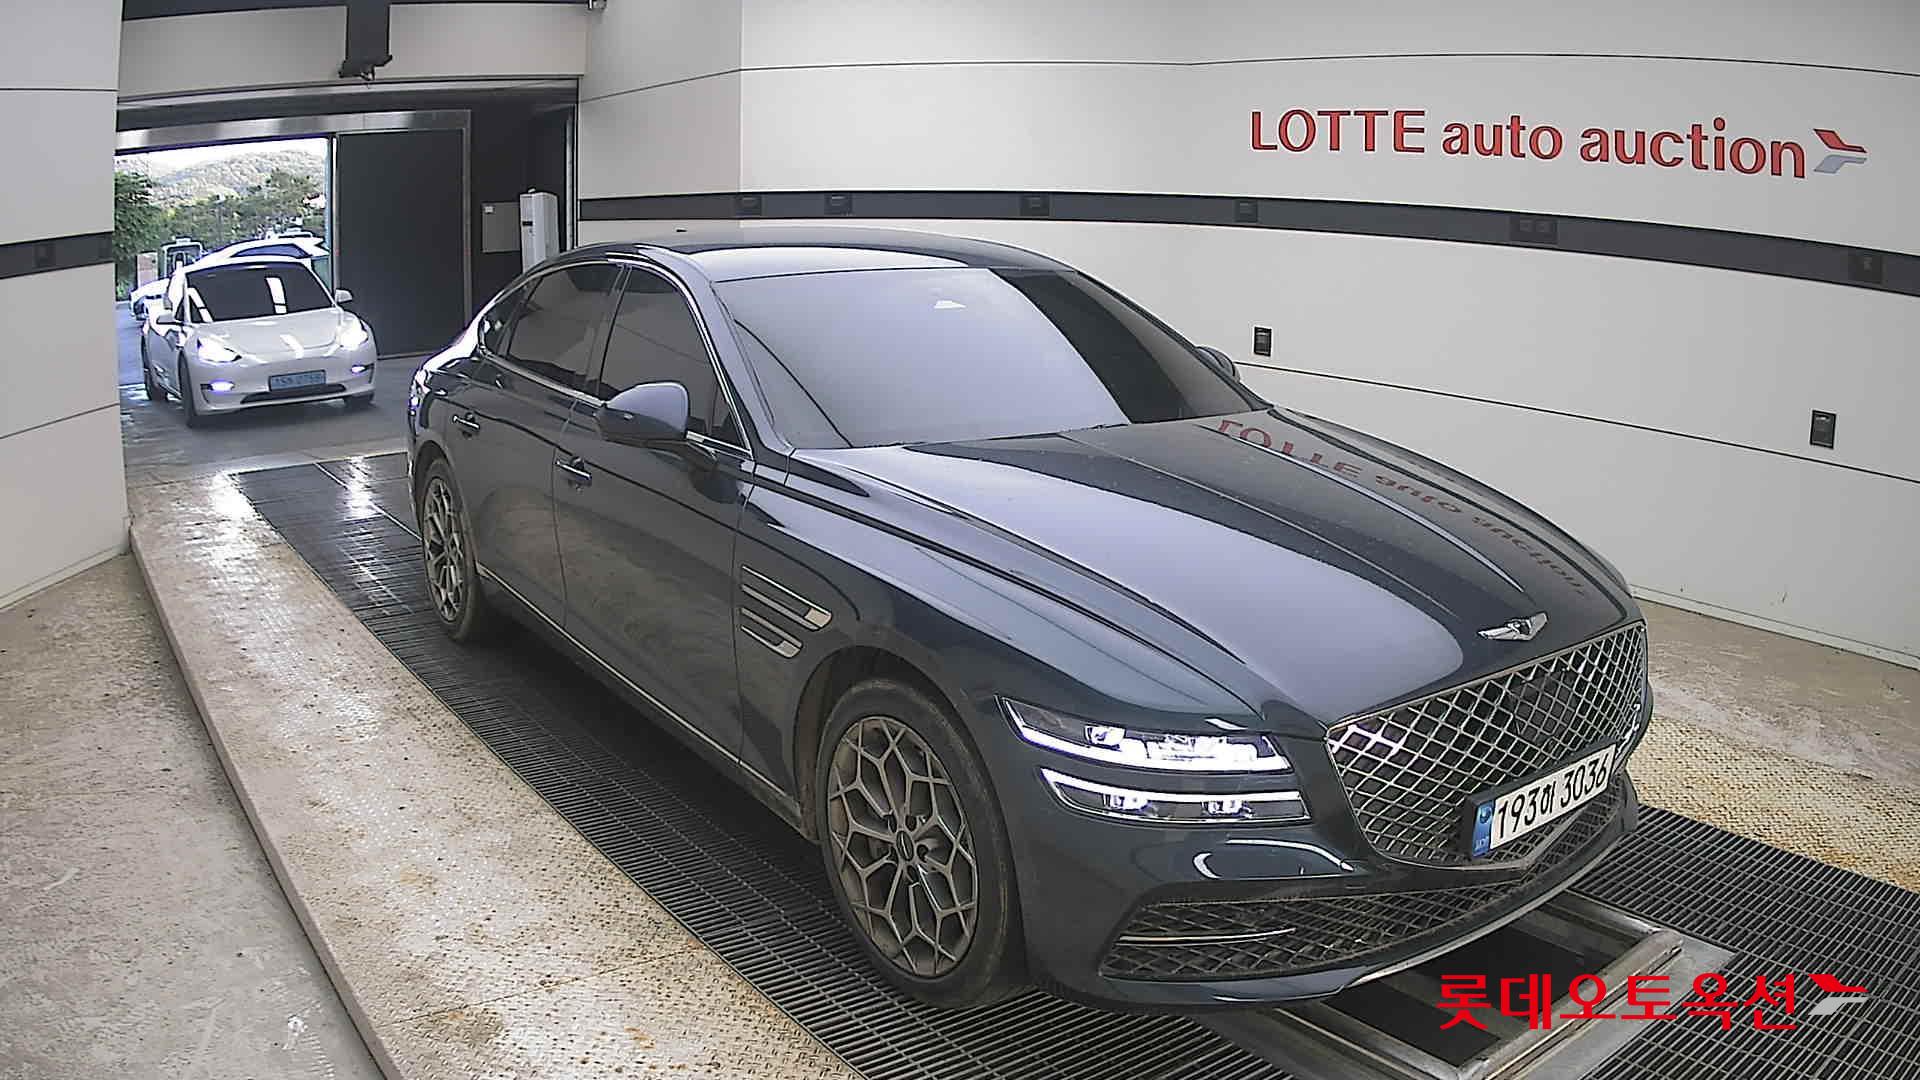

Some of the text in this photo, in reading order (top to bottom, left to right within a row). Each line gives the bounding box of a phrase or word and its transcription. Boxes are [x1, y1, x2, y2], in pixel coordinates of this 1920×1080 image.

[1251, 109, 1807, 178] LOTTE auto auction
[1560, 752, 1610, 809] 3036
